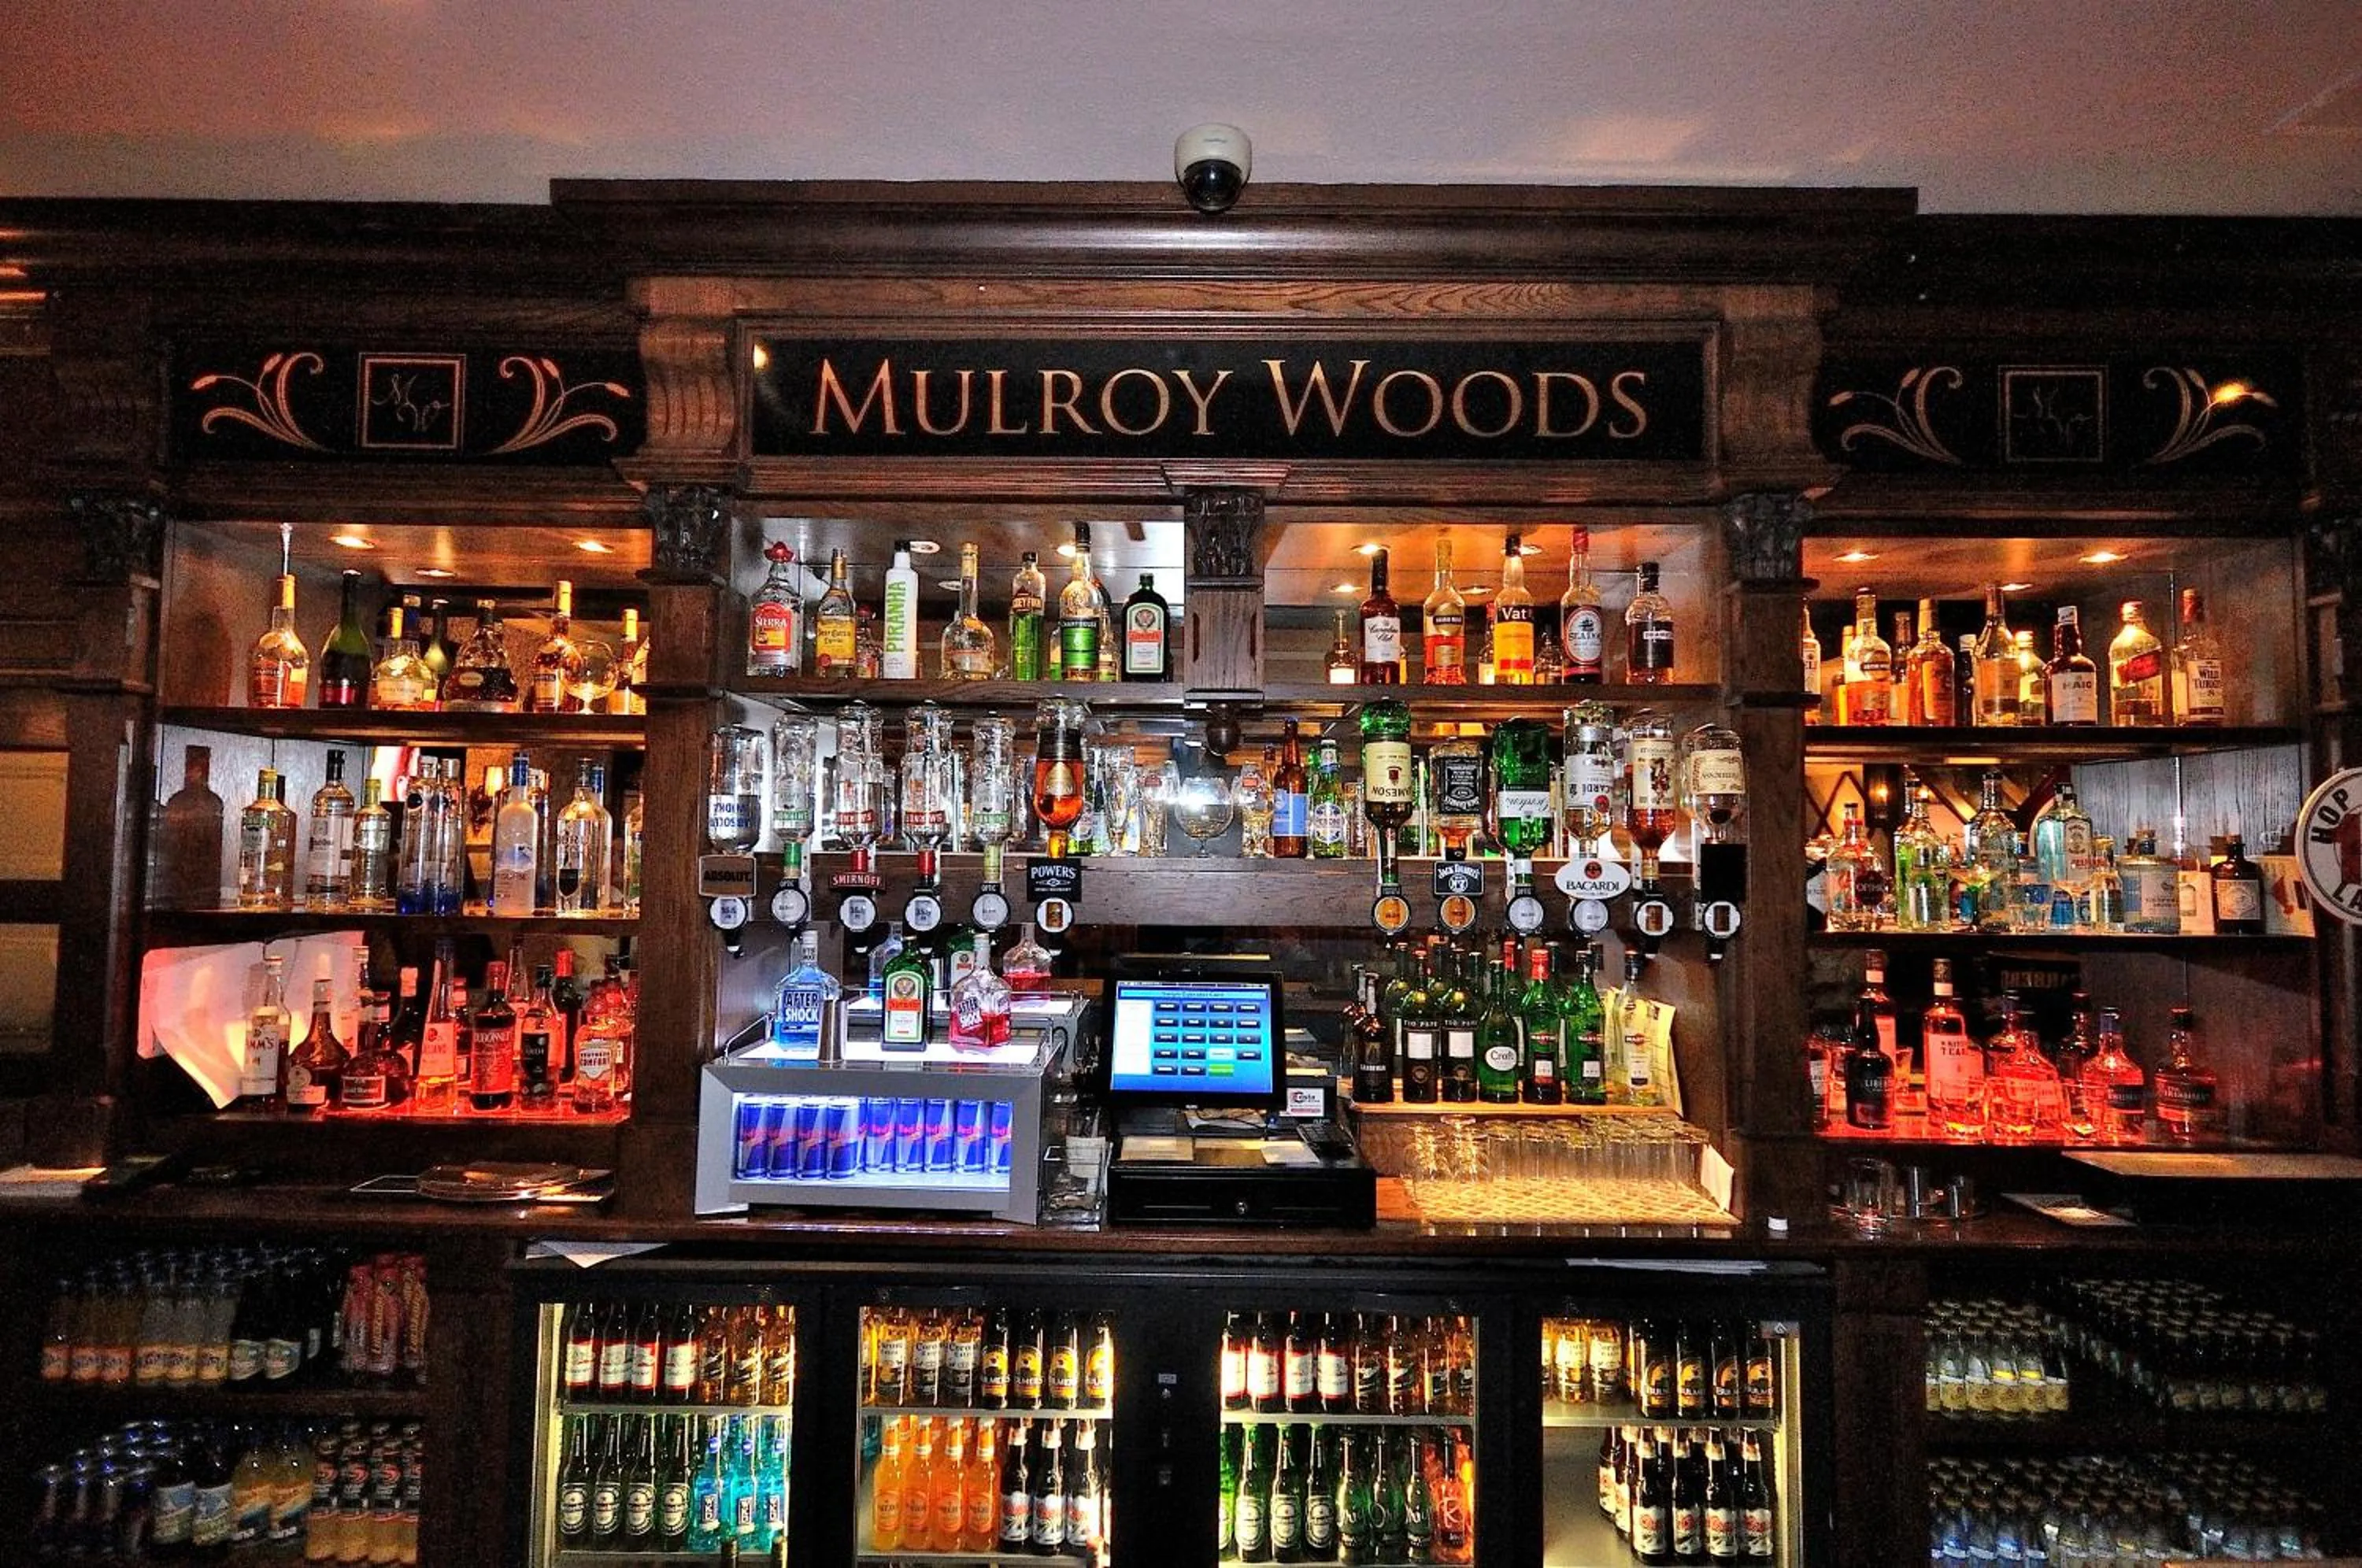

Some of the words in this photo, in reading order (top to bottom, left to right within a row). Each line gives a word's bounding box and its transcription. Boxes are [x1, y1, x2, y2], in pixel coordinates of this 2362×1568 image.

[810, 357, 1233, 437] MULROY
[1261, 359, 1648, 438] WOODS
[886, 580, 907, 653] PIRANHA
[1501, 608, 1527, 620] Vat
[755, 617, 787, 628] SIERRA
[1372, 786, 1412, 797] AMESON
[2311, 787, 2349, 845] HOP
[1031, 865, 1078, 879] POWERS
[831, 875, 883, 886] SMIRNOFF
[1565, 880, 1620, 891] BACARDI
[787, 992, 820, 1008] AFTER
[785, 1008, 820, 1023] SHOCK
